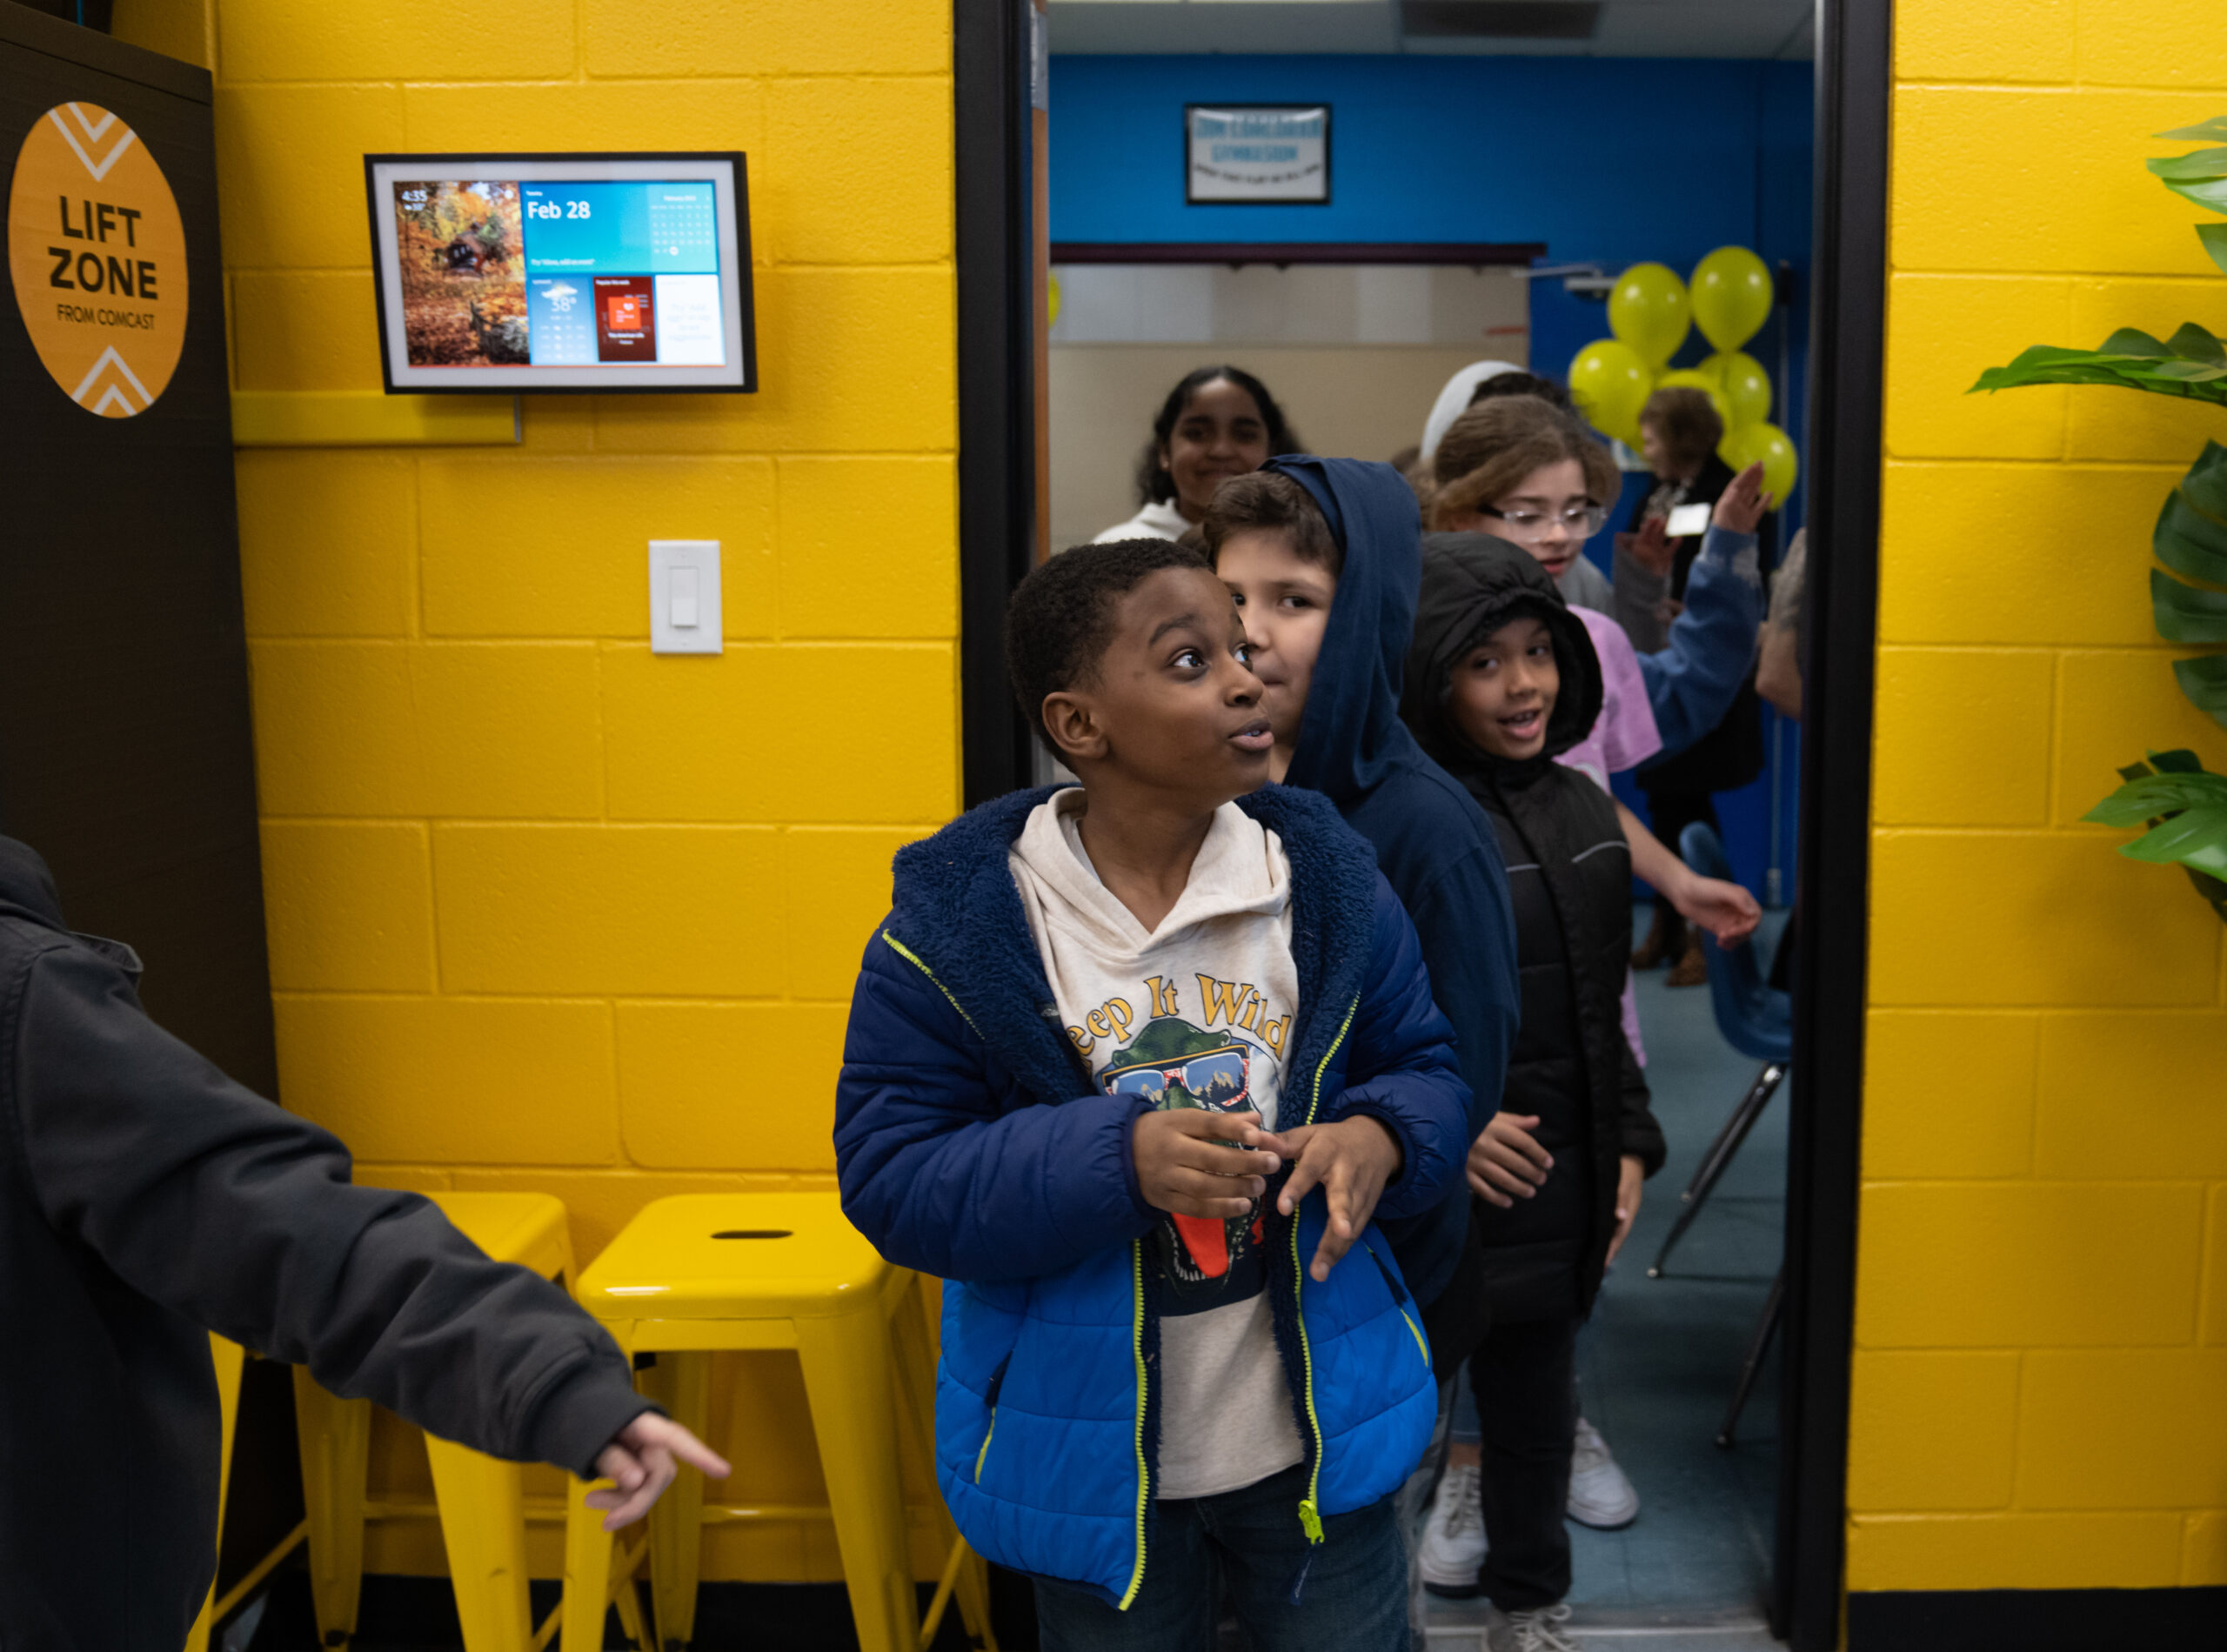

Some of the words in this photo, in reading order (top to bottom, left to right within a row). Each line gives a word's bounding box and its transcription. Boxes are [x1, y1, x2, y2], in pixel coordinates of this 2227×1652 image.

[402, 190, 428, 202] 4:35
[527, 200, 562, 219] Feb
[566, 201, 592, 219] 28
[59, 195, 142, 248] LIFT
[47, 246, 159, 300] ZONE
[57, 304, 96, 324] FROM
[97, 309, 155, 330] COMCAST
[1065, 997, 1134, 1070] eep
[1143, 975, 1180, 1019] It
[1194, 973, 1292, 1062] Wild
